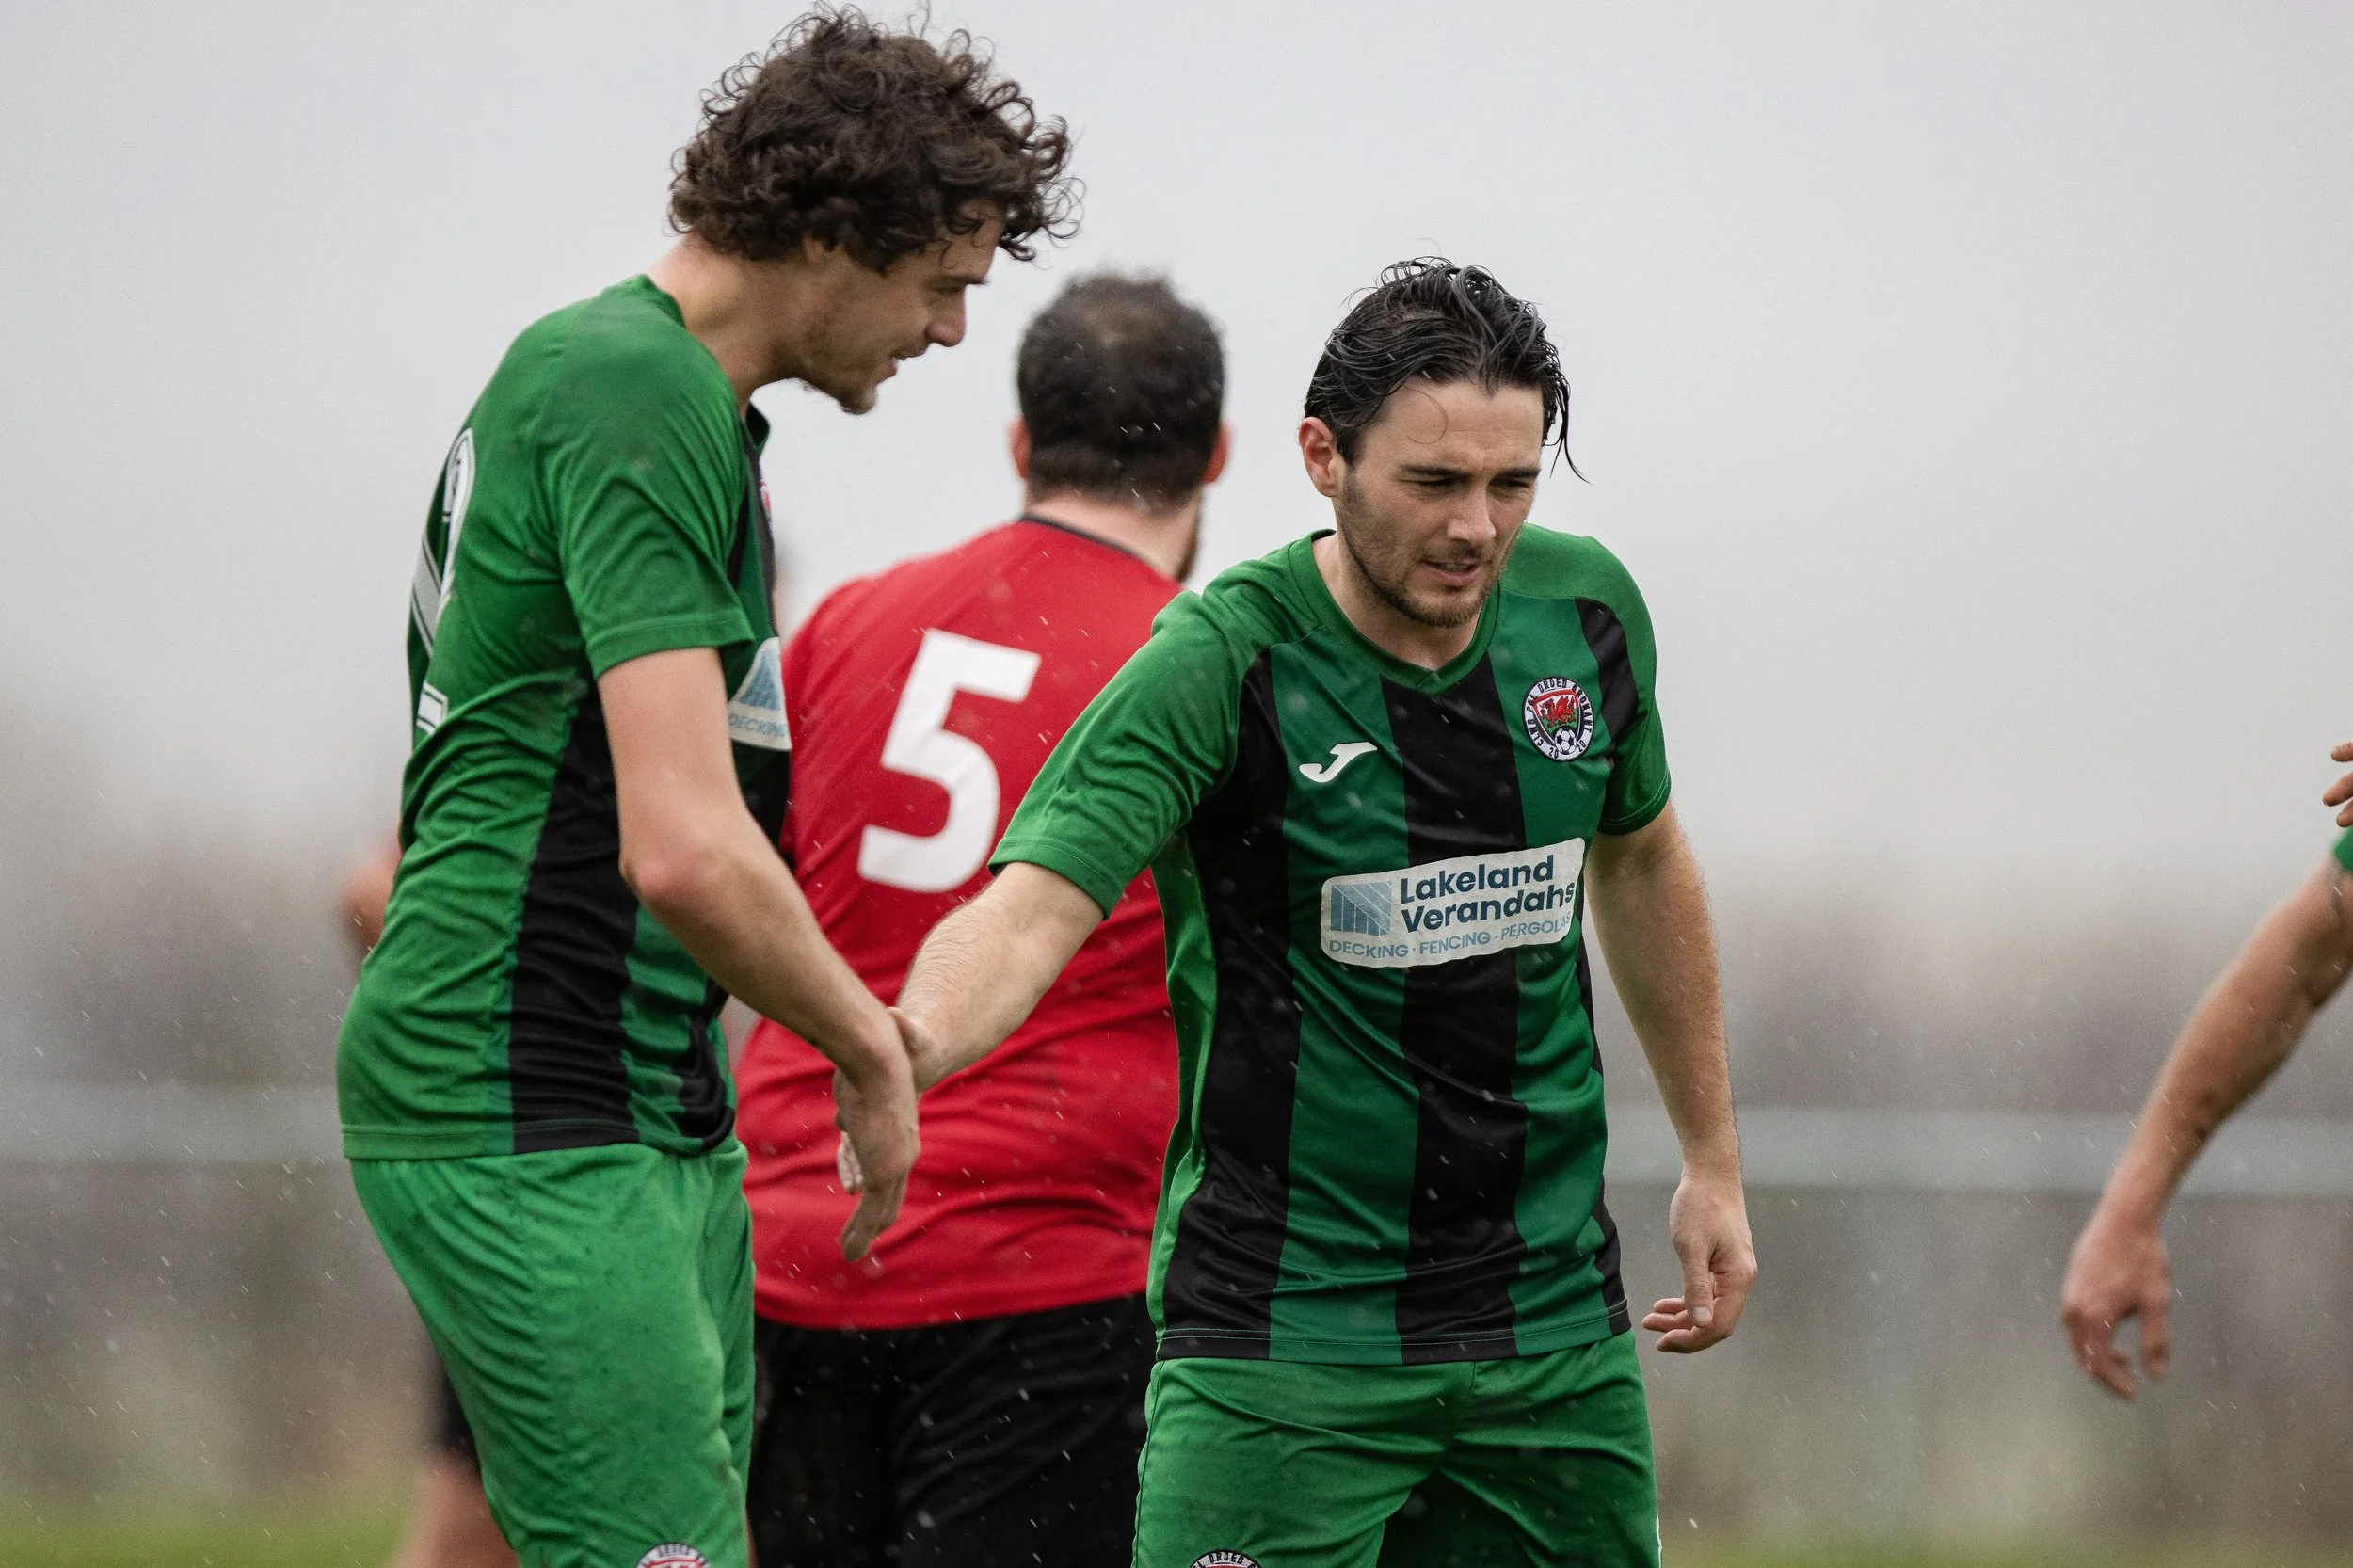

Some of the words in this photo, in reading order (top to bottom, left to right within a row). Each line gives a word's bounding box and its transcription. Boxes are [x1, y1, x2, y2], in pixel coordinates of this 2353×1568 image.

[1537, 679, 1568, 693] DROED
[857, 627, 1042, 893] 5
[1401, 855, 1554, 904] Lakeland
[1401, 882, 1575, 933] Verandahs
[1329, 940, 1409, 958] DECKING
[1419, 931, 1491, 955] FENCING
[1501, 911, 1571, 939] PERGOLAS
[1209, 1552, 1244, 1564] DROED
